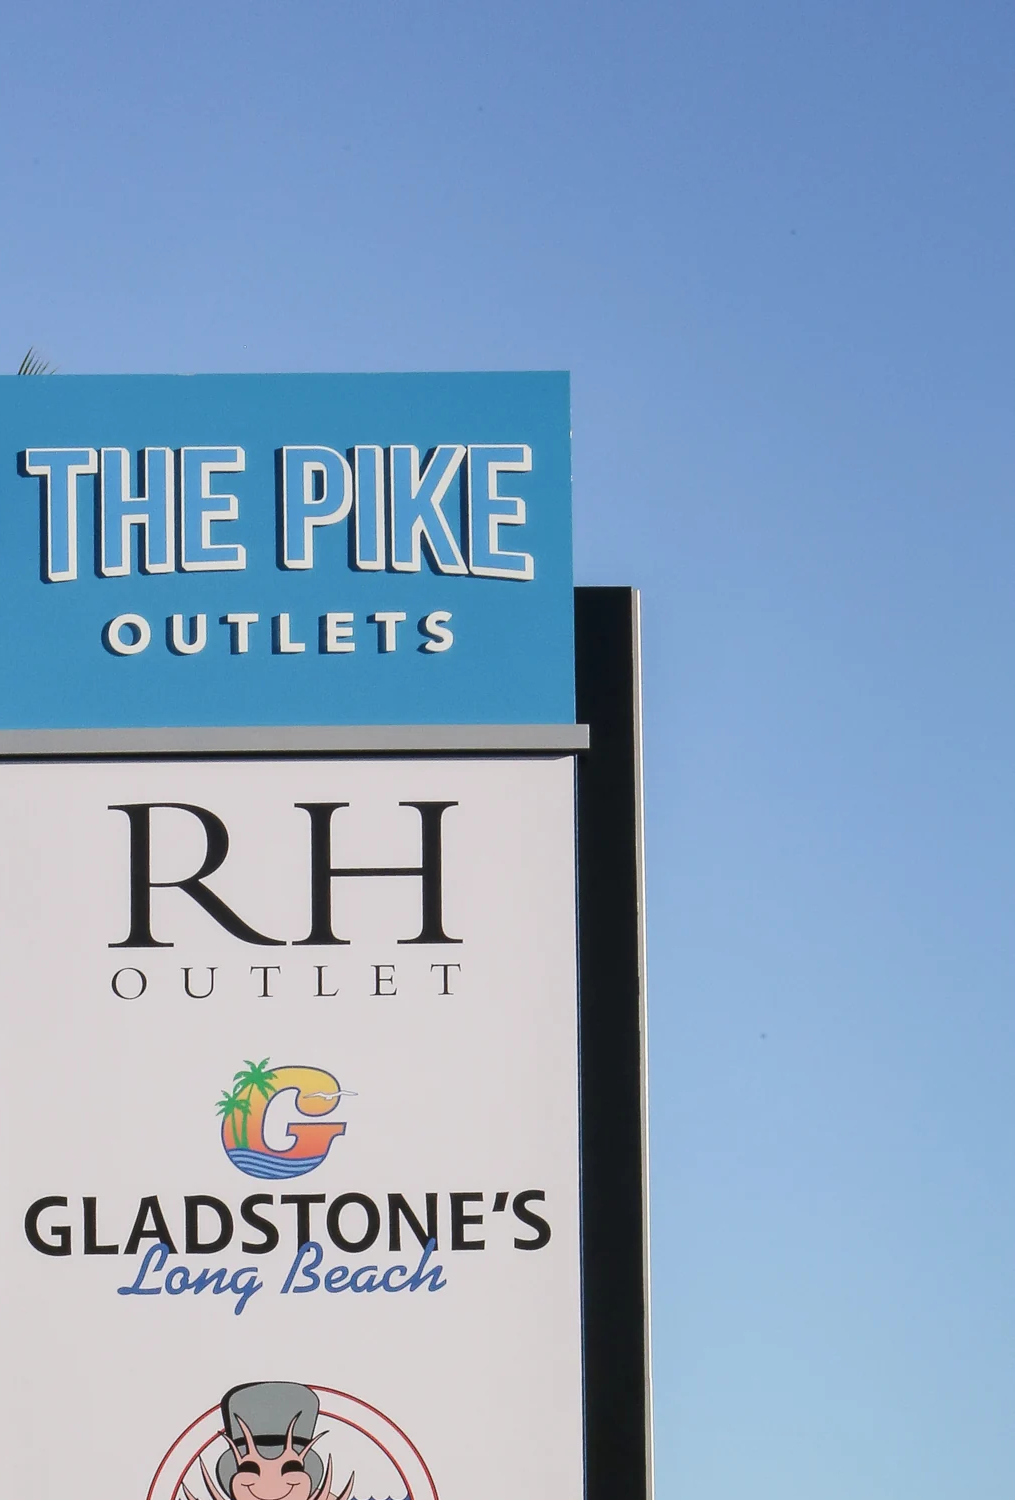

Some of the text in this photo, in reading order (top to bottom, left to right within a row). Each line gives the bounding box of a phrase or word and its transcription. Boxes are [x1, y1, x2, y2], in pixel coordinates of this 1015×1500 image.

[21, 444, 535, 583] THE PIKE
[105, 610, 454, 655] OUTLETS
[107, 801, 464, 948] RH
[111, 962, 463, 1000] OUTLET
[24, 1189, 552, 1257] GLADSTONE'S
[117, 1238, 447, 1316] Long Beach
